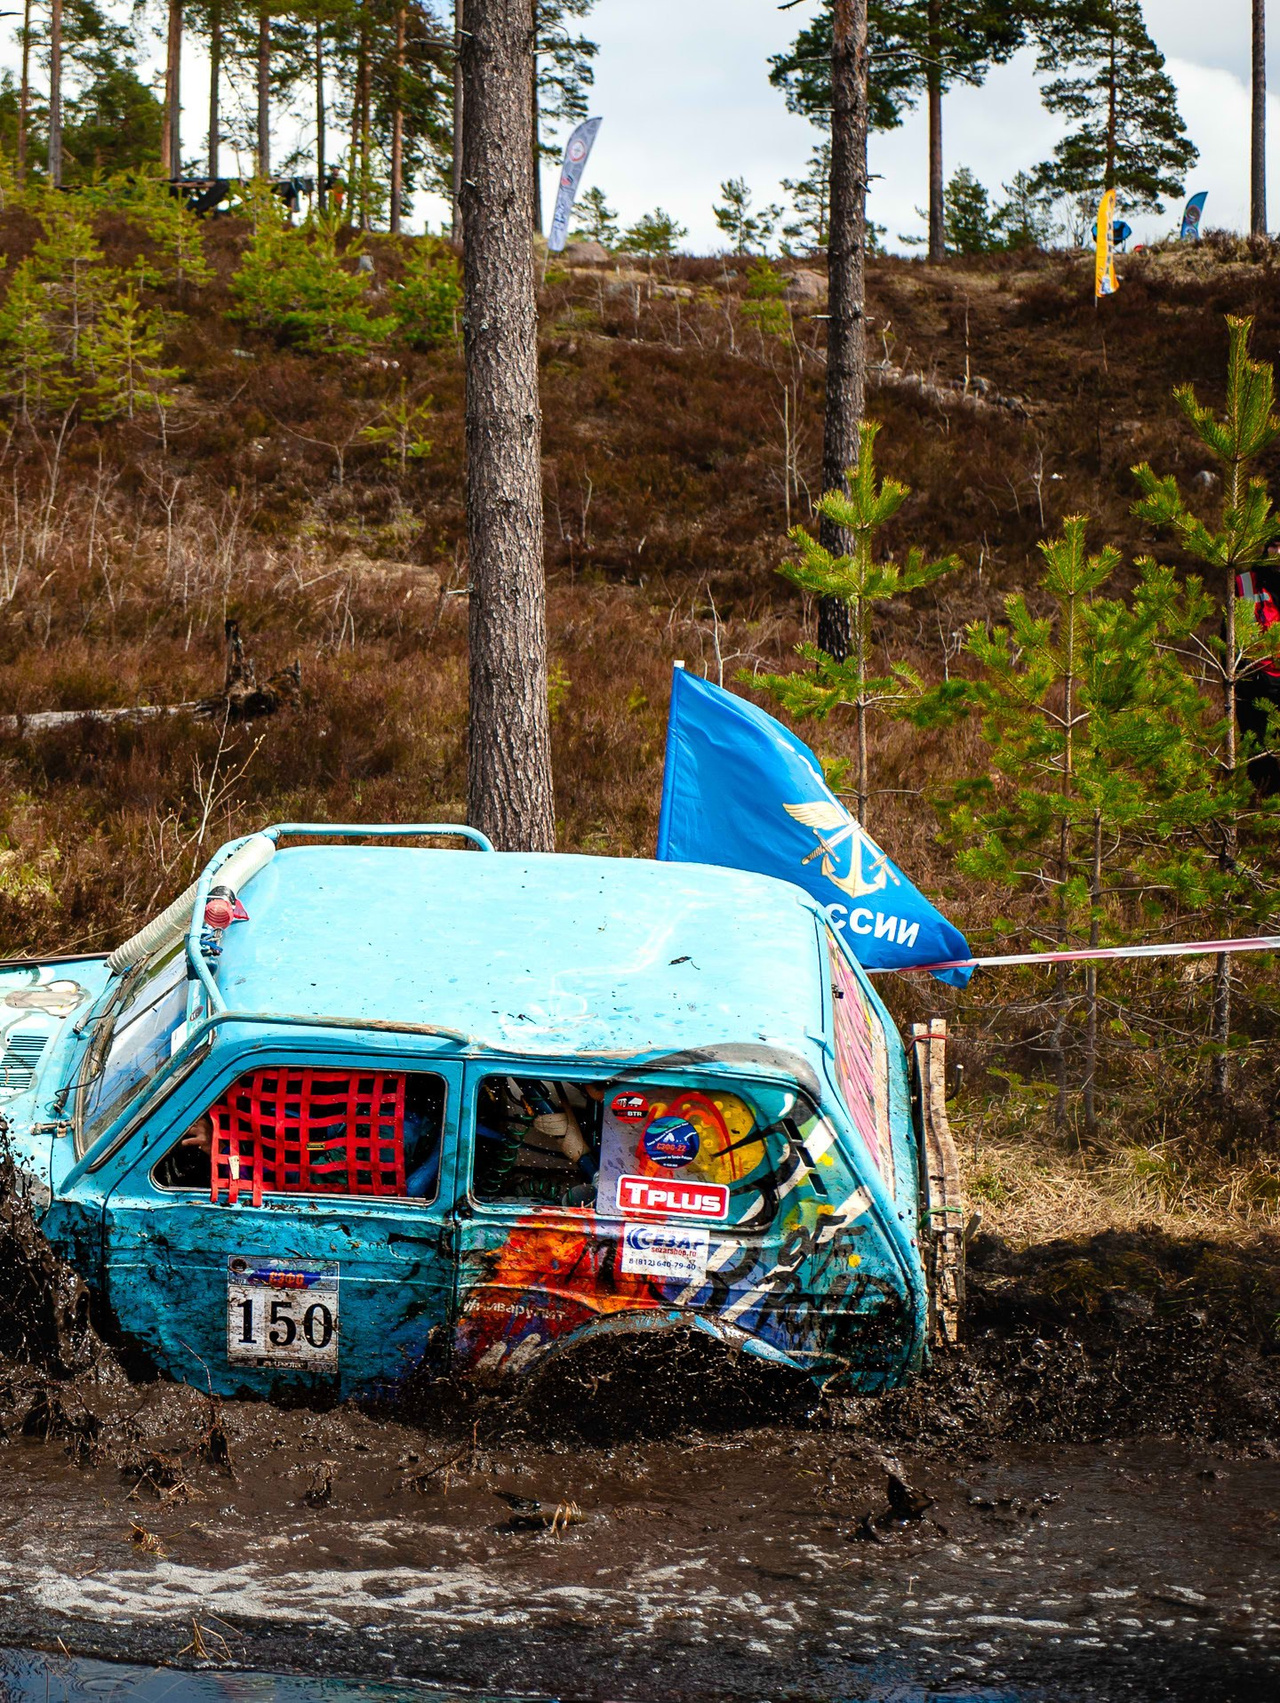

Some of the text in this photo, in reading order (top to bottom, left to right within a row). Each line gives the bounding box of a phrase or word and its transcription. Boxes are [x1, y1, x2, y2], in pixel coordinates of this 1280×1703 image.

[625, 1182, 721, 1212] TPLUS
[651, 1246, 697, 1258] sezarshop.ru
[636, 1258, 655, 1267] (812)
[656, 1260, 697, 1271] 640-79-40
[236, 1299, 333, 1349] 150
